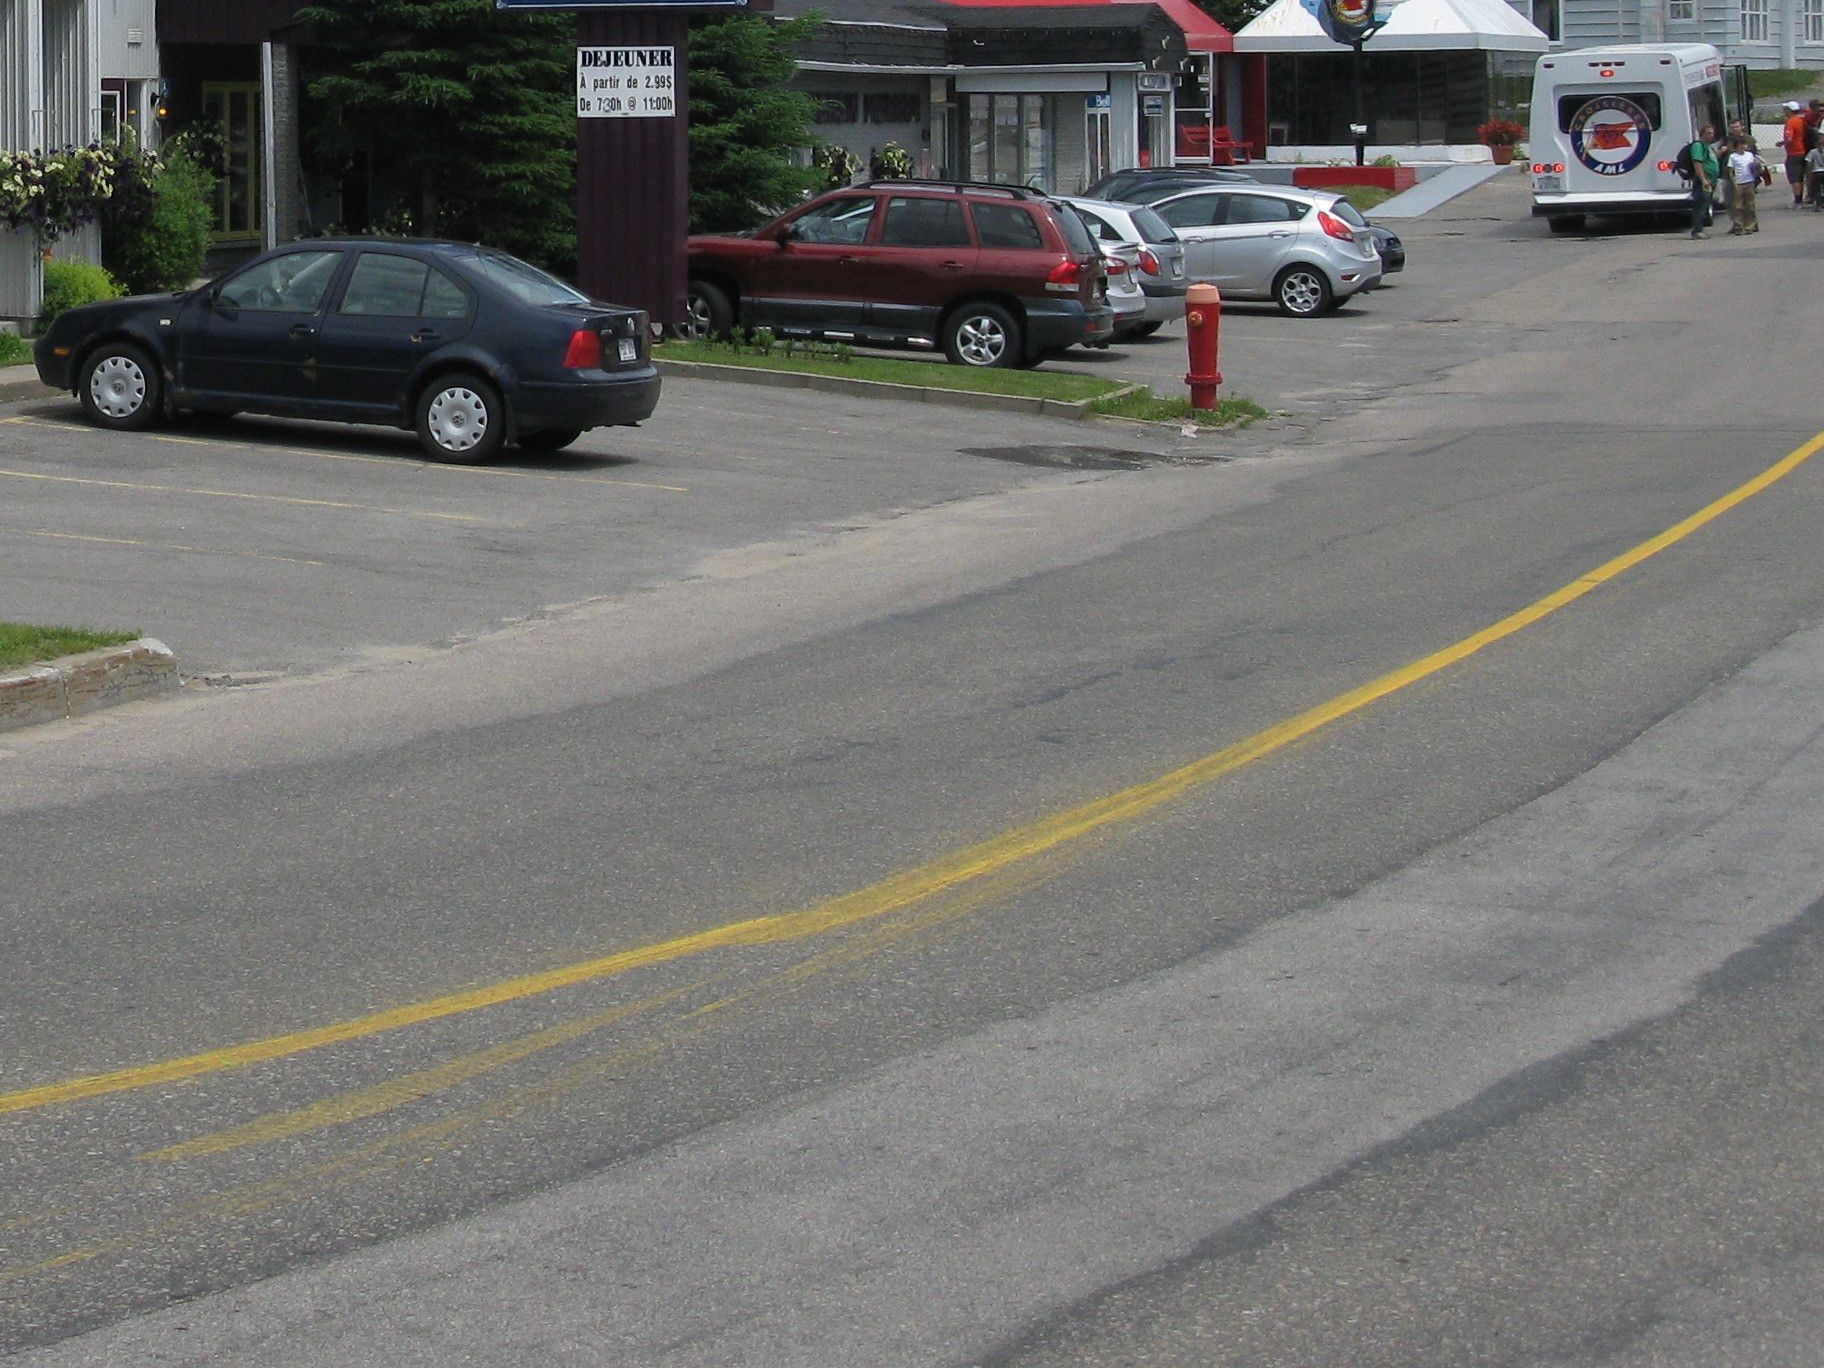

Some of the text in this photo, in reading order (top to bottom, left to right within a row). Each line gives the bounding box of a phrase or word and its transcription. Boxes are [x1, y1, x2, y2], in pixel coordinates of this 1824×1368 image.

[580, 49, 673, 68] DEJEUNER
[593, 75, 621, 92] partir
[626, 75, 638, 89] de
[645, 74, 673, 90] 2.99$
[579, 97, 591, 111] De
[642, 97, 673, 111] 11:00h
[1593, 162, 1626, 175] AML
